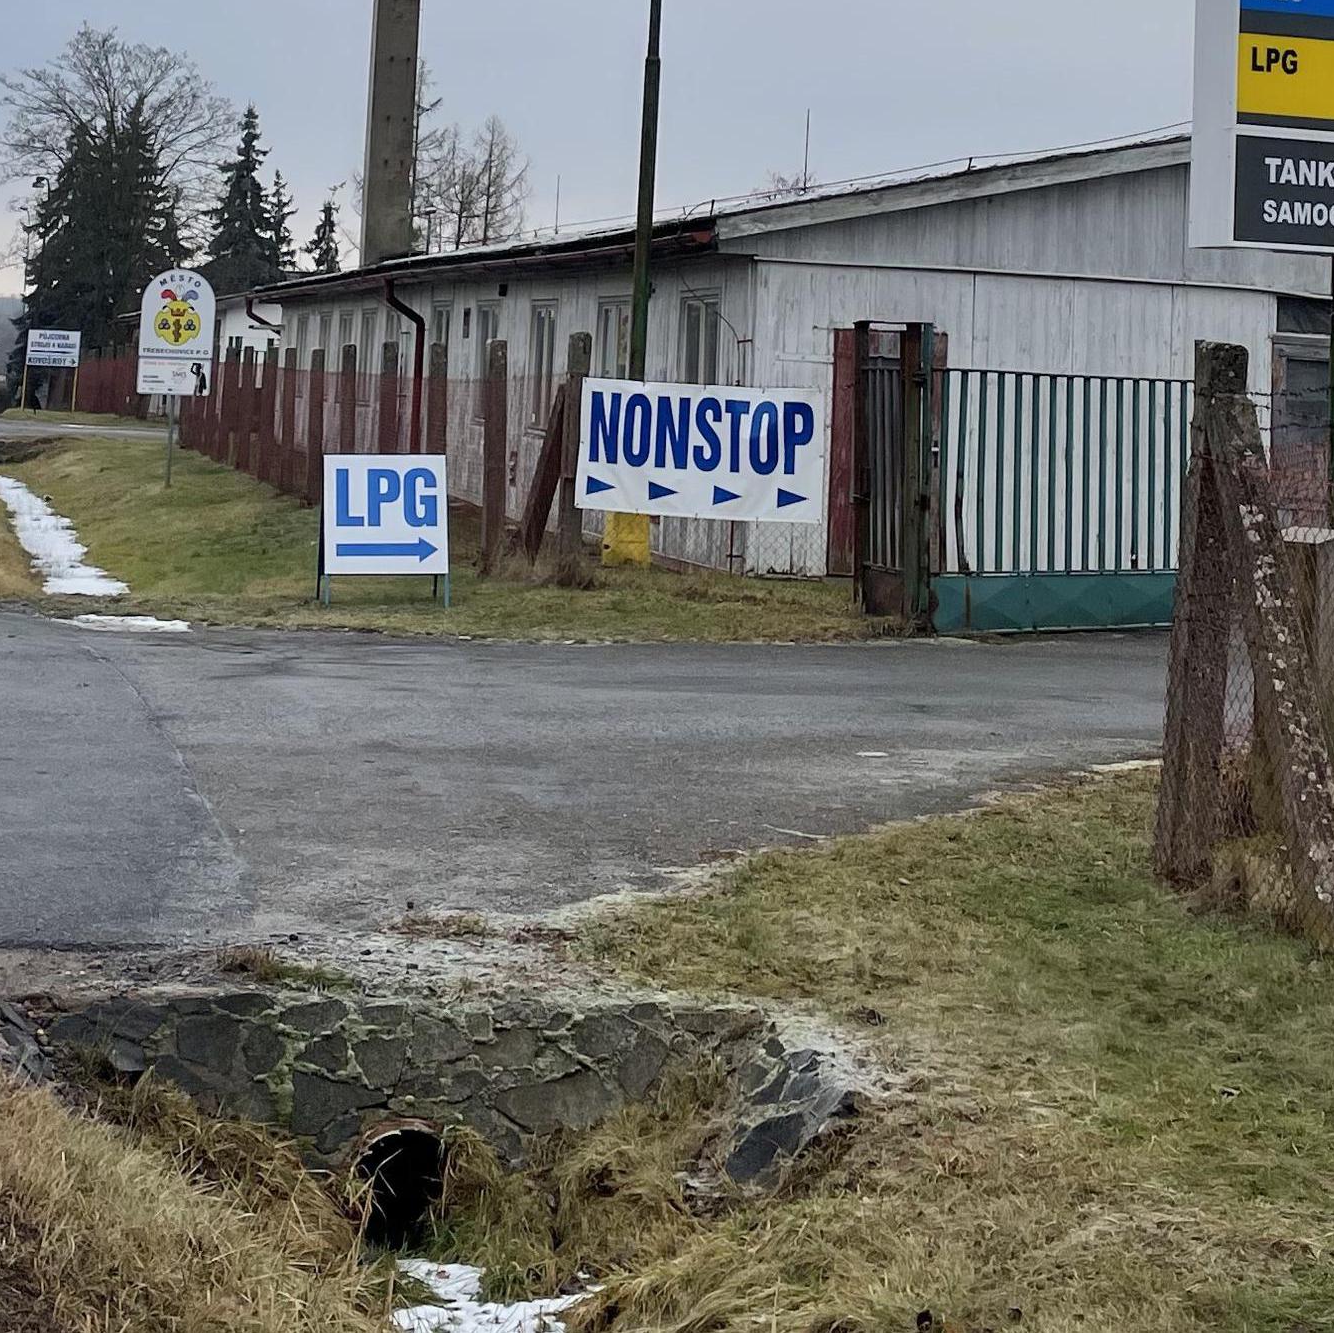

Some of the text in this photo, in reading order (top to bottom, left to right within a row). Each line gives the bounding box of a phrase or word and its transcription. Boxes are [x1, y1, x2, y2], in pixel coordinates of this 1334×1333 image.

[1251, 46, 1299, 75] LPG
[588, 390, 815, 475] NONSTOP
[335, 468, 438, 527] LPG
